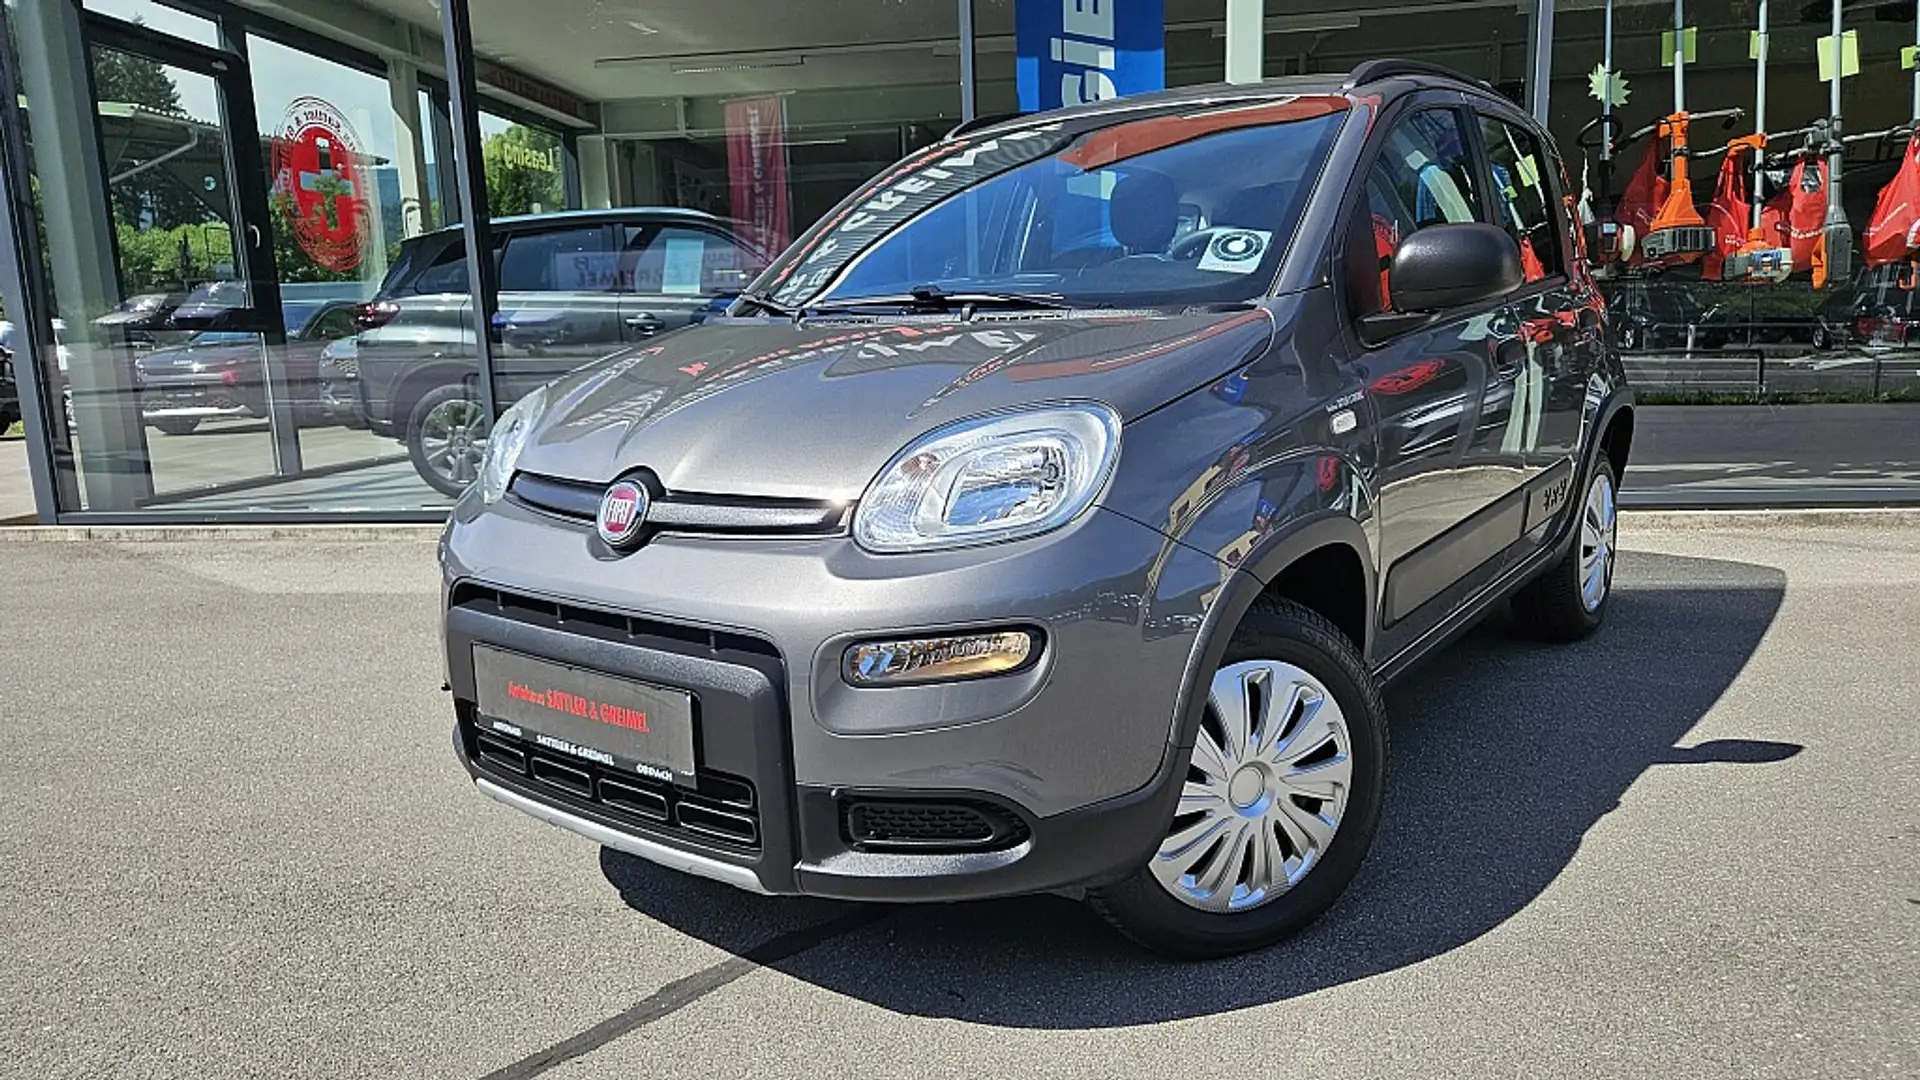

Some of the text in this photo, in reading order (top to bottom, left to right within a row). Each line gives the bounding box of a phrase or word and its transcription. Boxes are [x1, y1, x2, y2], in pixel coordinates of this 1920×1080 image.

[606, 497, 635, 524] FIAT
[546, 688, 588, 718] SATTLER
[589, 701, 599, 720] &
[600, 703, 650, 733] GREIMEL
